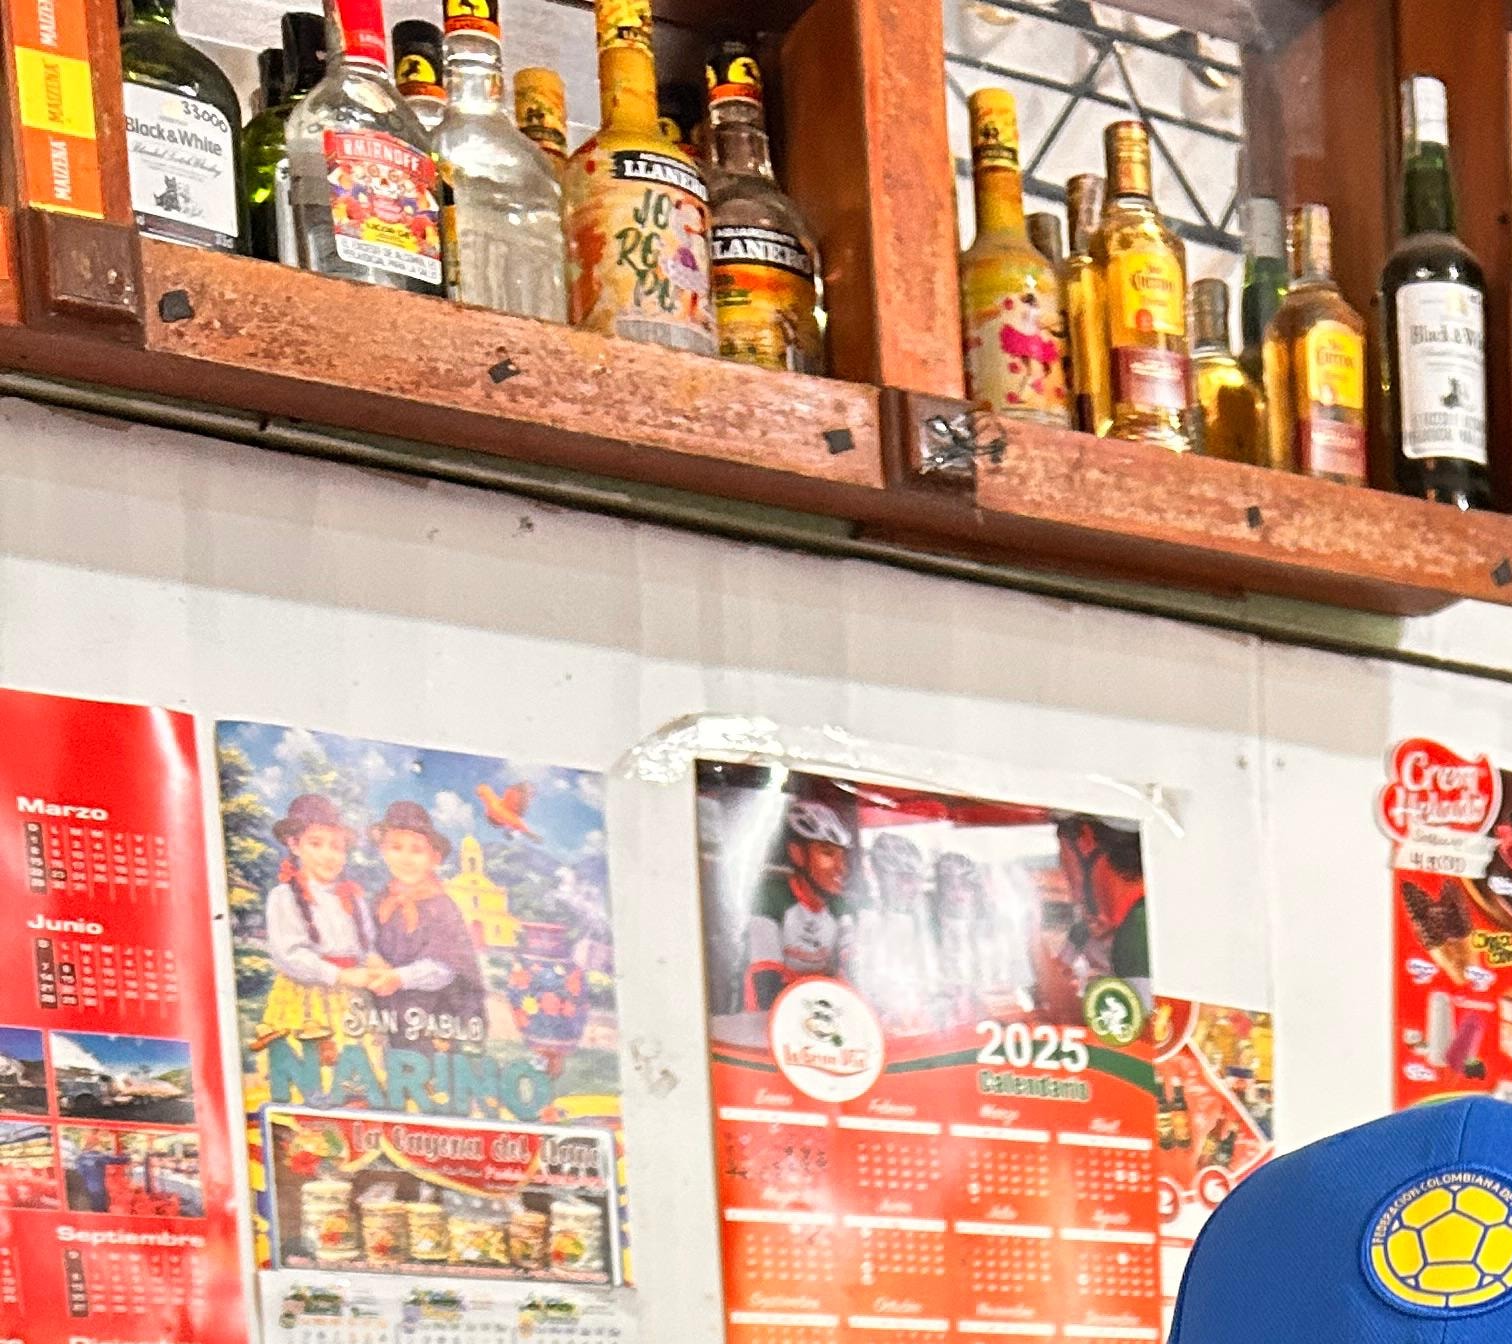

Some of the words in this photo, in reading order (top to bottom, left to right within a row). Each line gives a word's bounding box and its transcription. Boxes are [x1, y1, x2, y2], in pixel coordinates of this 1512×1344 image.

[17, 796, 109, 821] Marzo
[27, 914, 104, 935] Junio
[976, 1021, 1089, 1073] 2025
[978, 1071, 1090, 1101] Calendario
[1420, 1172, 1501, 1193] COLOMBIANA
[56, 1226, 205, 1247] Septiembre
